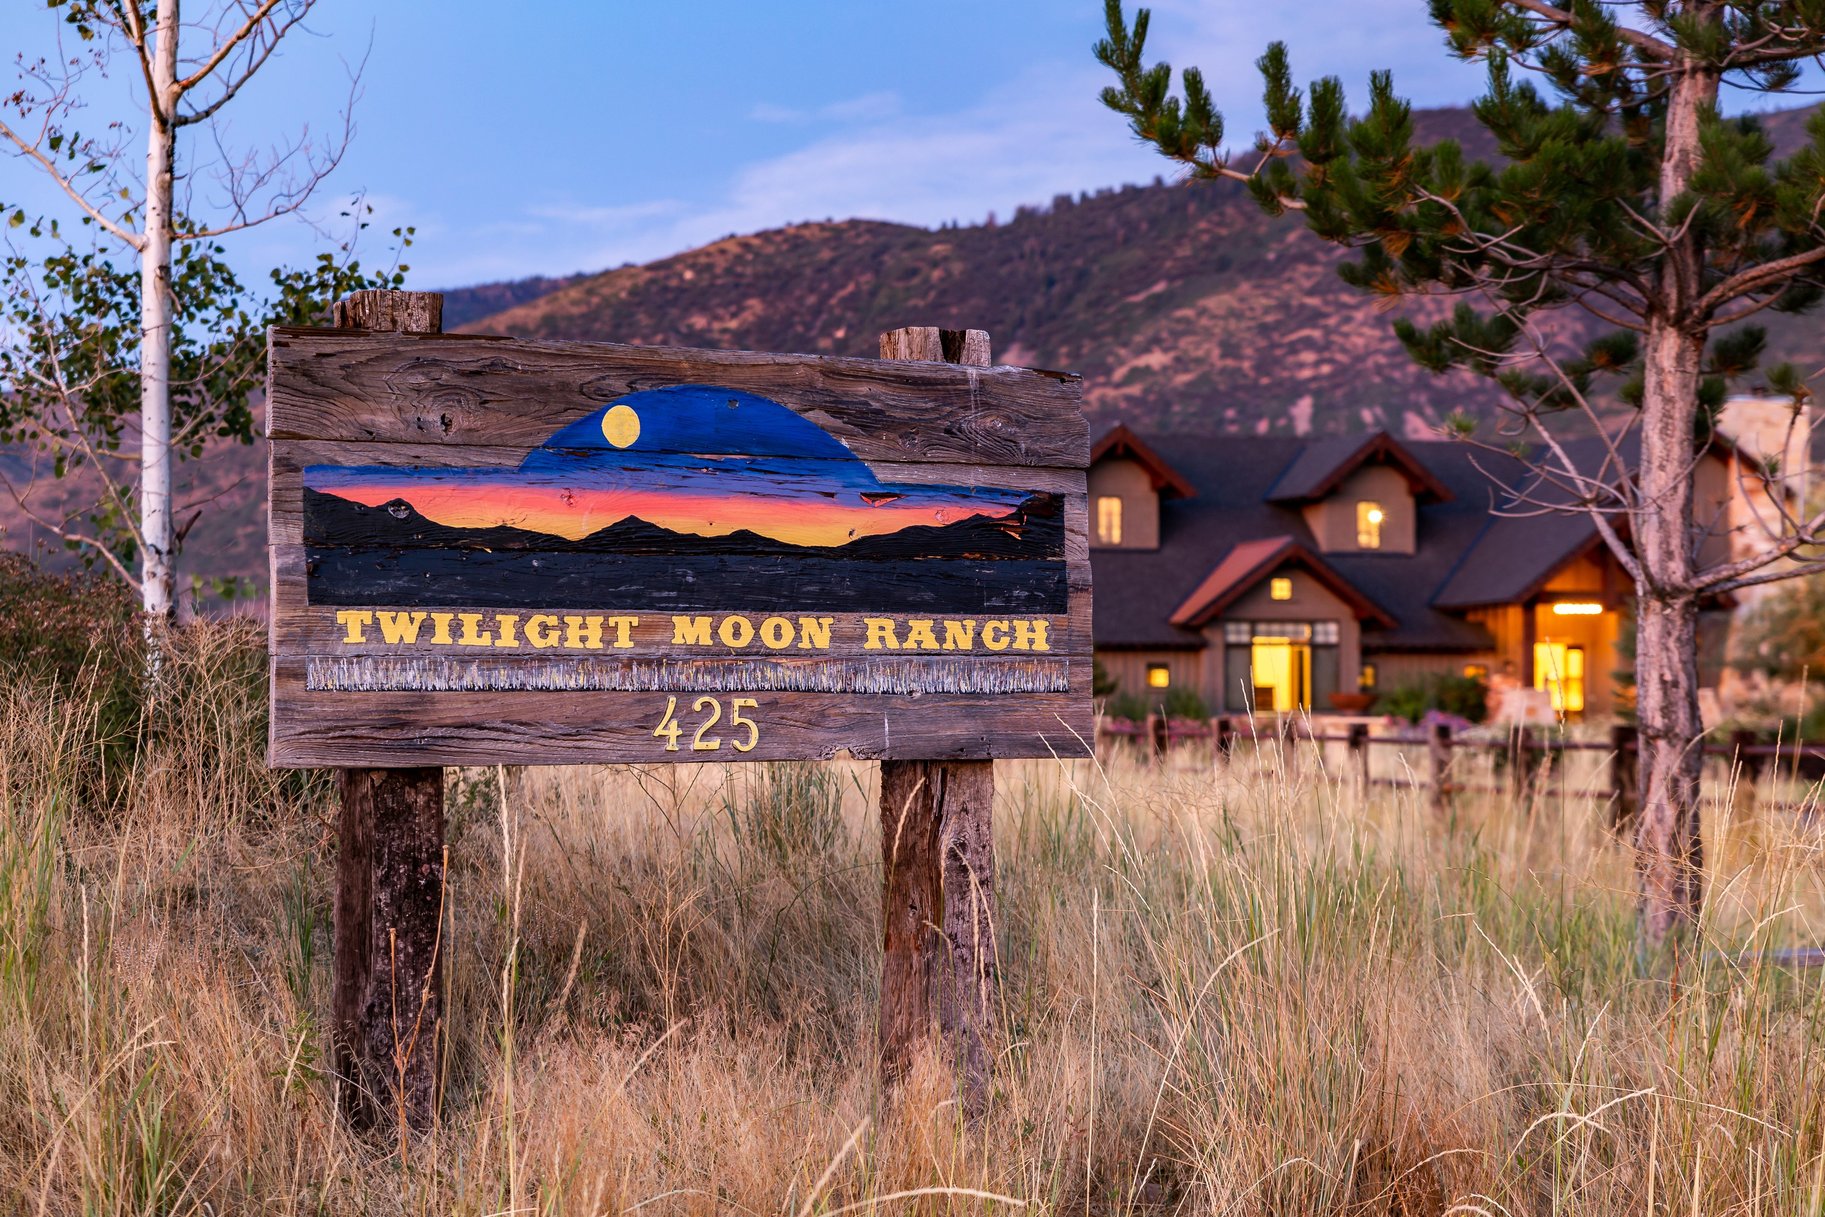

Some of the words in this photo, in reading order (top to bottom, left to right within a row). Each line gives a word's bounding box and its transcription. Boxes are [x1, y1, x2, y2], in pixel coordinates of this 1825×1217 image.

[336, 610, 639, 648] TWILIGHT
[671, 615, 833, 649] MOON
[863, 617, 1050, 651] RANCH
[653, 696, 759, 751] 425
